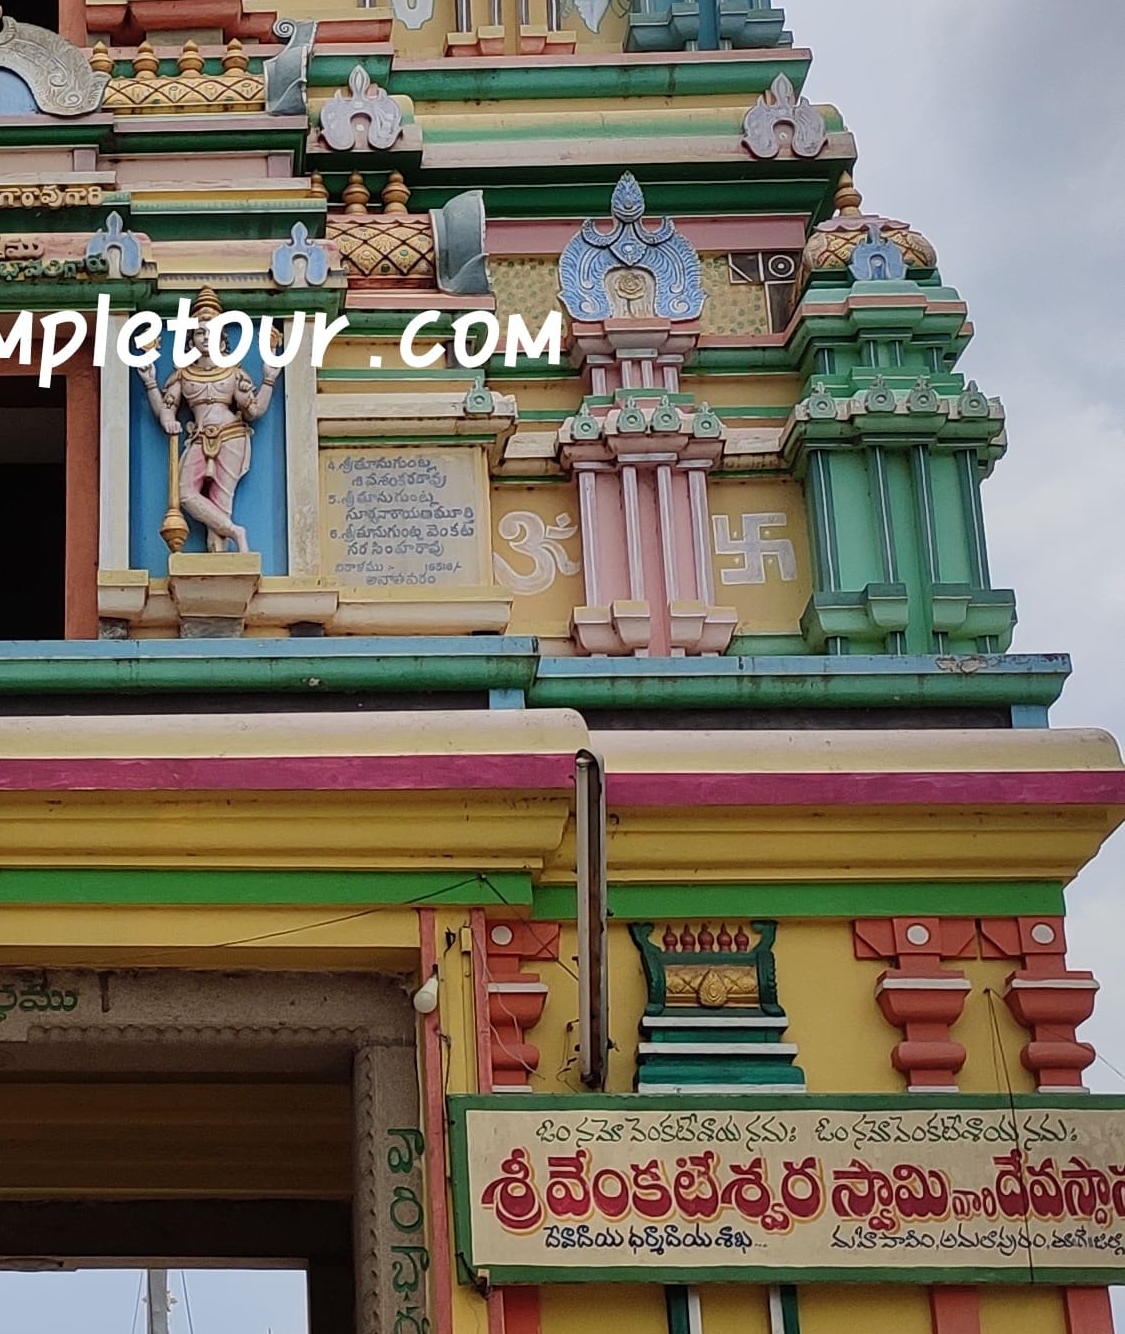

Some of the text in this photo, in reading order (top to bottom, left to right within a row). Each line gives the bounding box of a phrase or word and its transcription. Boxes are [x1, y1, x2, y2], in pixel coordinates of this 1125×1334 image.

[535, 1116, 571, 1145] ఓం
[815, 1117, 853, 1144] ఓం
[481, 1148, 543, 1231] శ్రీ
[832, 1158, 951, 1231] స్వామి
